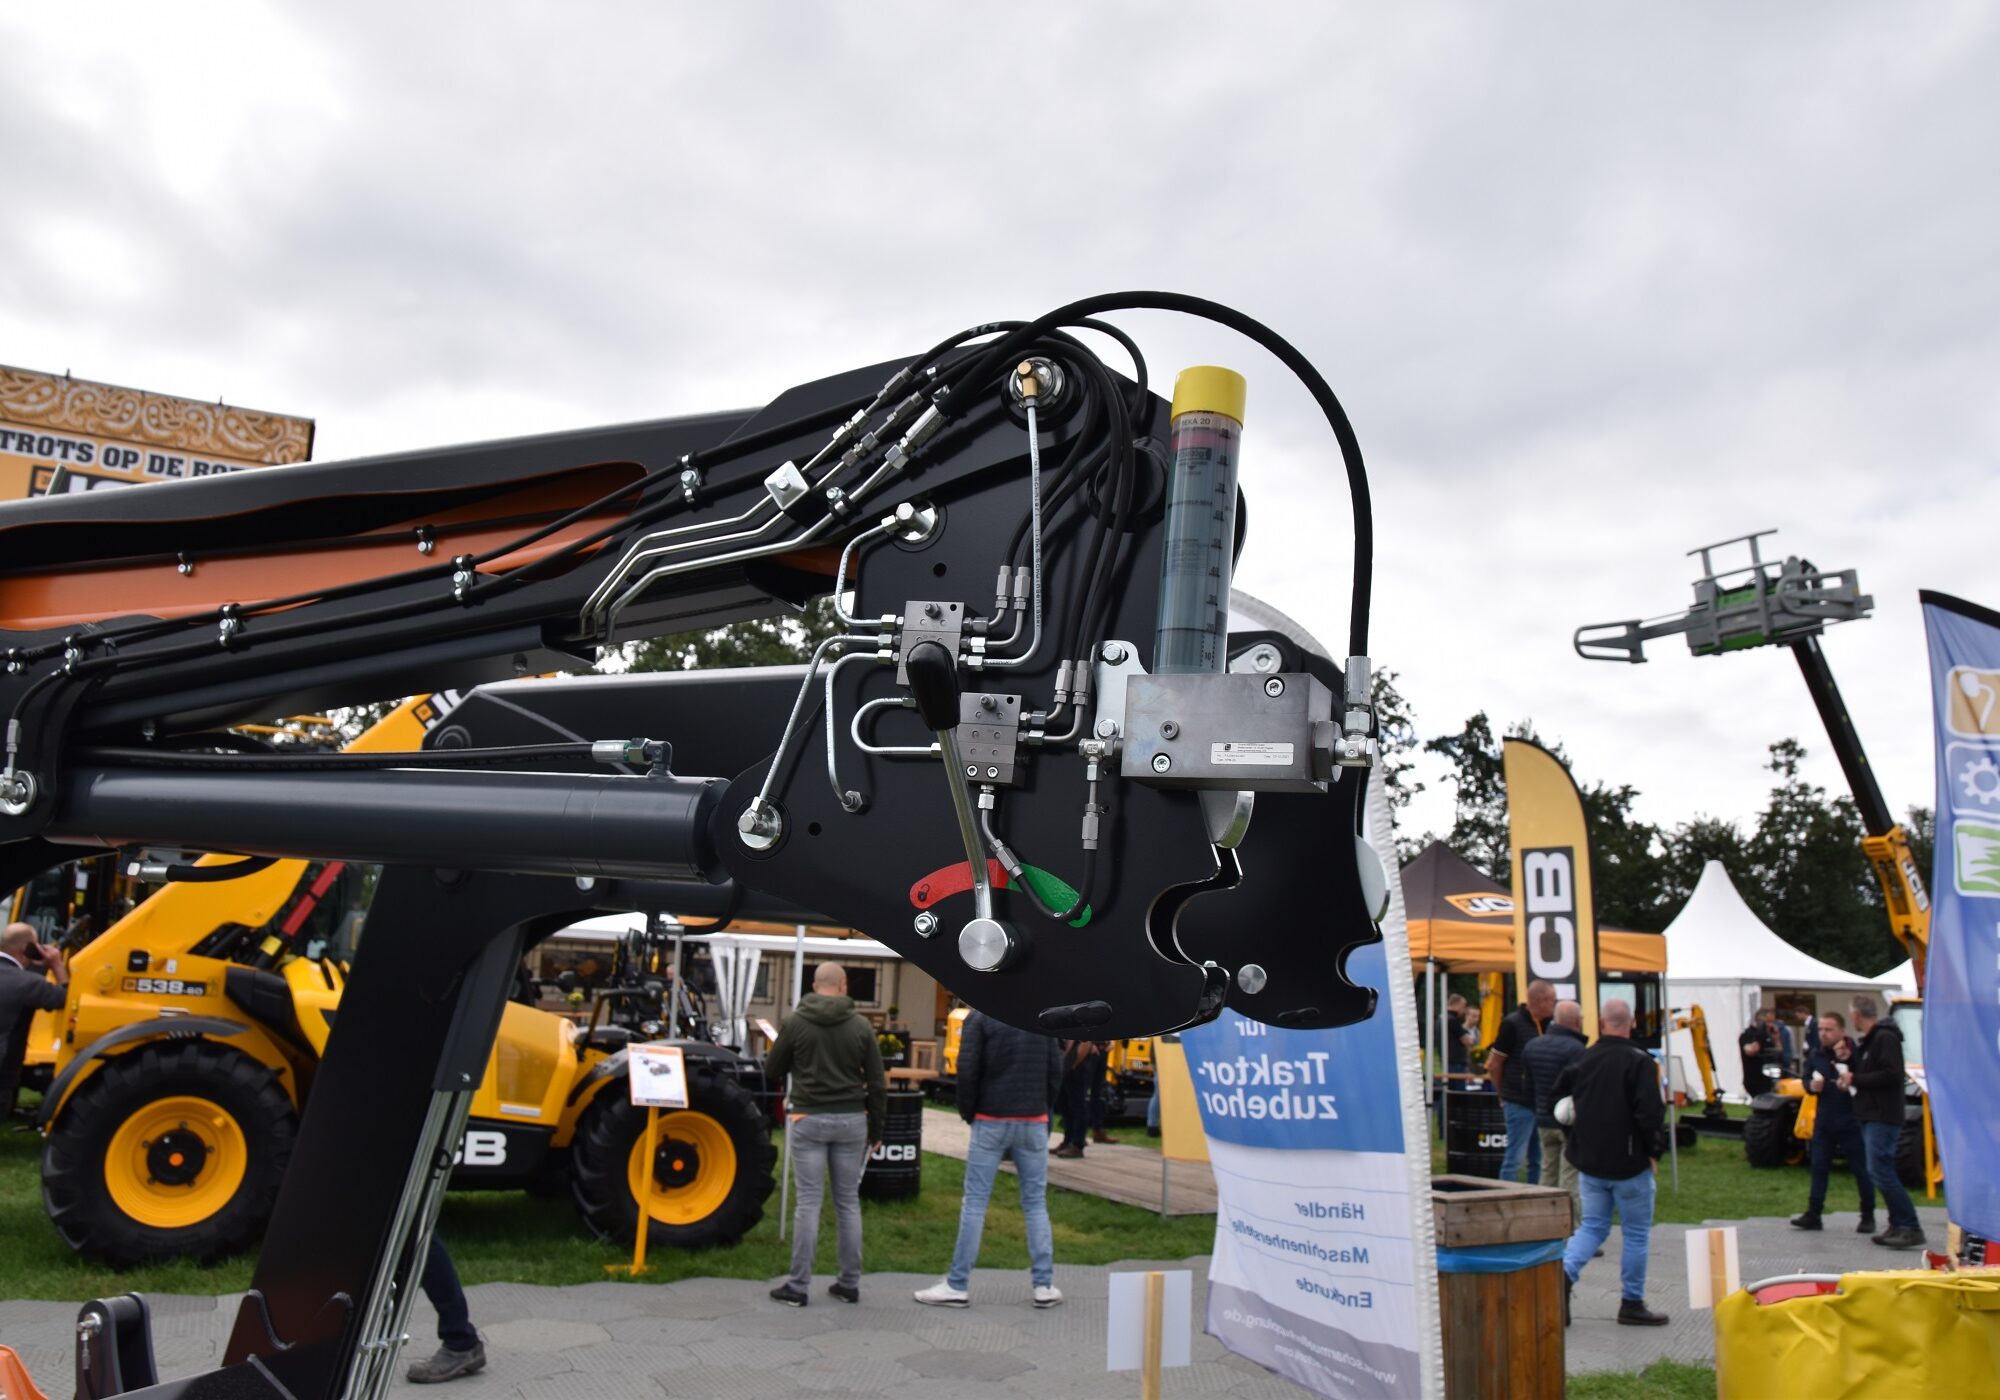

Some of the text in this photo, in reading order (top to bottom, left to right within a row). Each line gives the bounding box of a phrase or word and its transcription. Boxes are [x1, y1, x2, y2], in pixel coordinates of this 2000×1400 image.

[0, 429, 95, 463] TROTS
[103, 445, 140, 469] OP
[148, 453, 184, 477] DE
[1204, 652, 1212, 660] 10
[1467, 896, 1515, 914] JC
[871, 1144, 917, 1161] JCB
